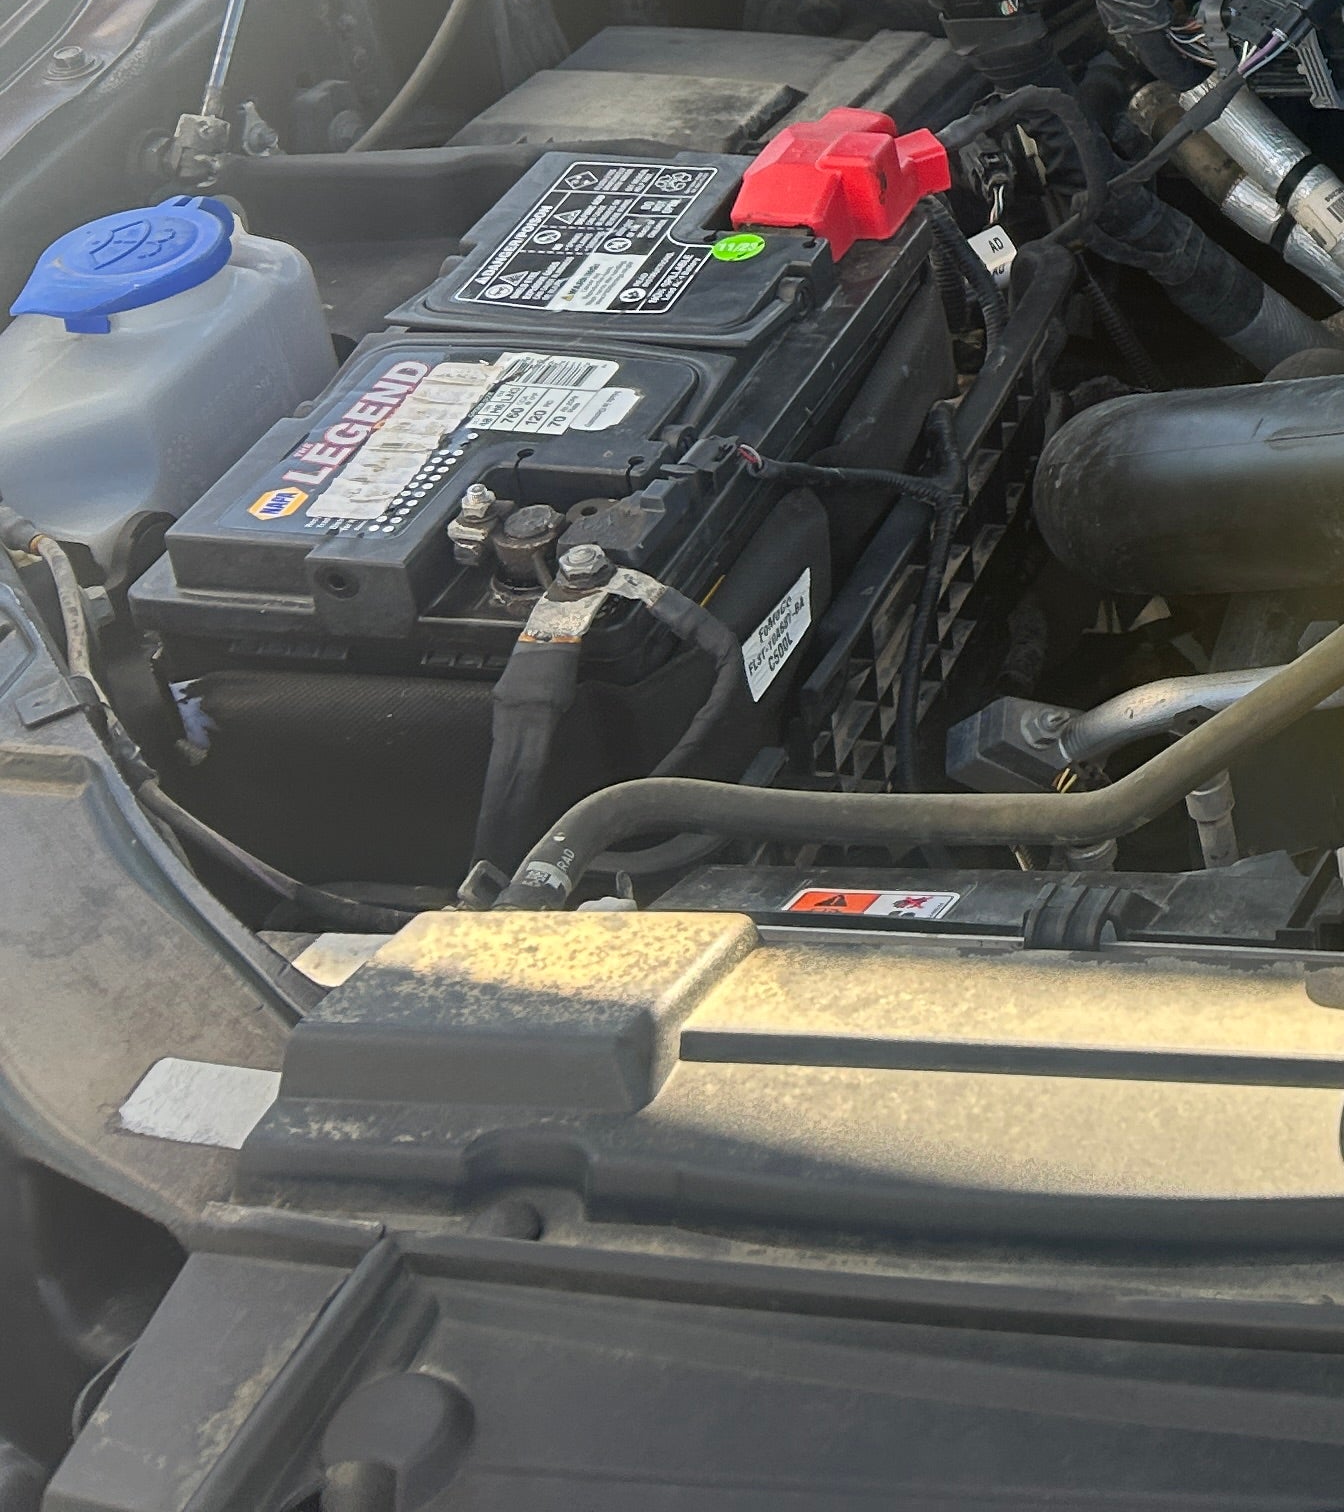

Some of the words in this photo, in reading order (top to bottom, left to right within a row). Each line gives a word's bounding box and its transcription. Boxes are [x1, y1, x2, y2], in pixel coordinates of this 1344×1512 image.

[988, 237, 1004, 254] AD
[281, 360, 432, 485] LEGEND
[500, 407, 525, 424] 760
[525, 410, 548, 426] 120
[547, 416, 567, 428] 70
[259, 492, 298, 515] NAPA
[556, 848, 575, 873] RAD
